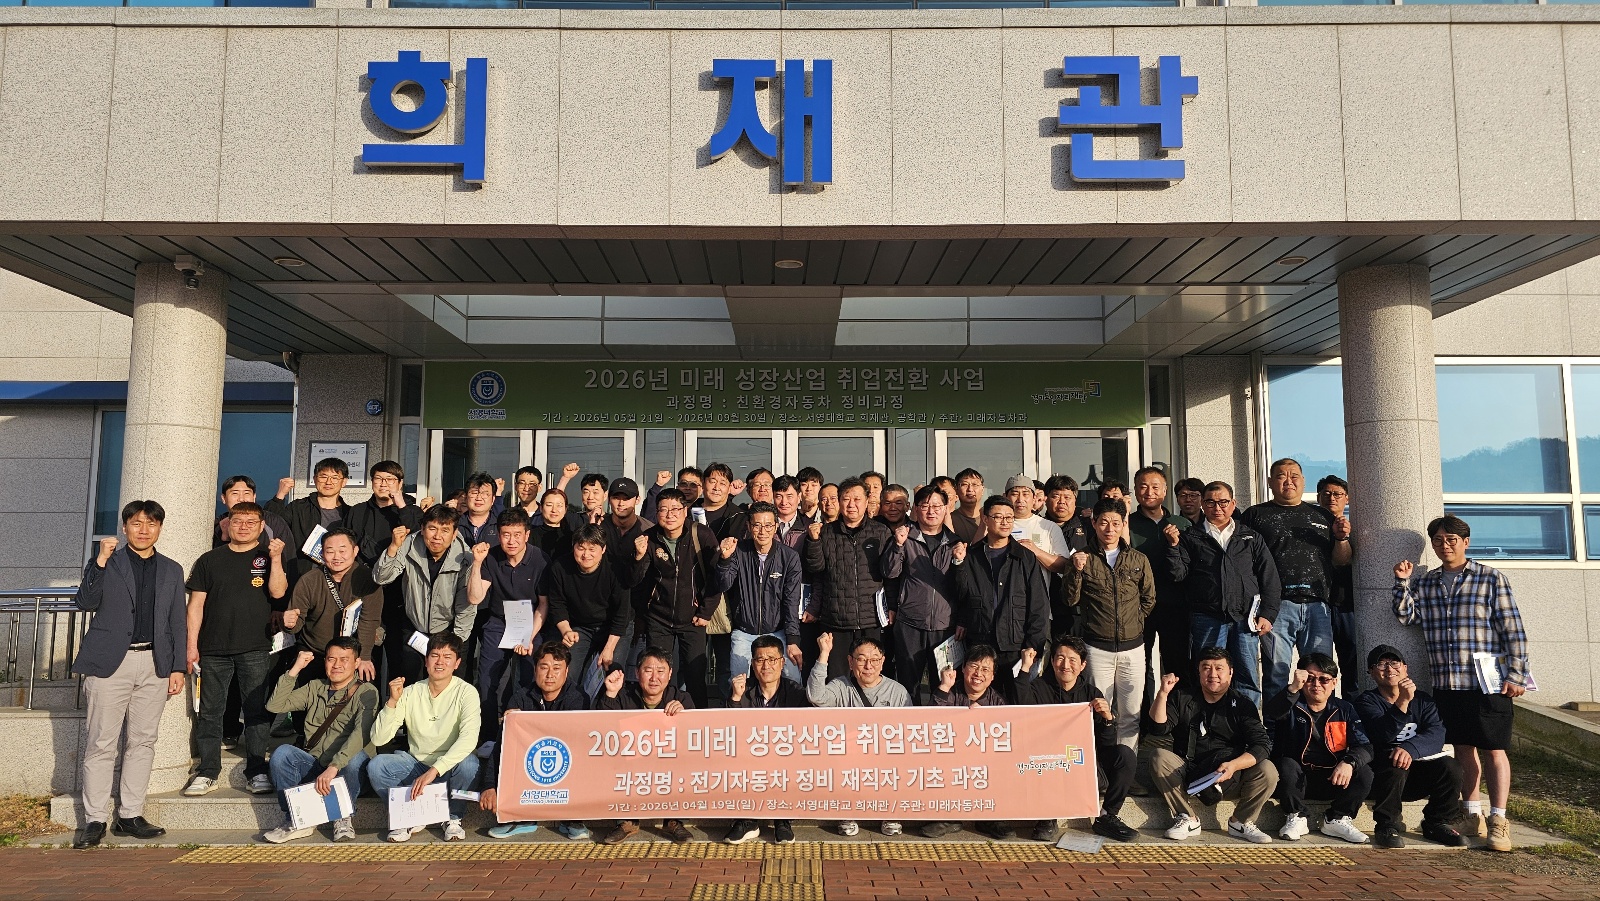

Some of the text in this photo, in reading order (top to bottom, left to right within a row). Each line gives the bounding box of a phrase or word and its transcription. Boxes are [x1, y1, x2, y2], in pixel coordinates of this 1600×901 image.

[361, 50, 1199, 185] 희 재 관
[584, 367, 985, 391] 2026년 미래 성장산업 취업전환 사업
[666, 394, 713, 410] 과정명
[736, 394, 832, 410] 친환경자동차
[841, 394, 904, 410] 정비과정
[542, 413, 562, 424] 기간
[573, 413, 610, 424] 2026년
[613, 413, 637, 424] 05월
[640, 413, 664, 424] 21일
[677, 413, 714, 424] 2026년
[717, 413, 740, 424] 09월
[743, 413, 767, 424] 30일
[779, 413, 802, 424] 장소:
[806, 413, 856, 424] 서영대학교
[859, 413, 893, 424] 희재관,
[897, 413, 927, 424] 공학관
[940, 413, 962, 424] 주관:
[967, 413, 1028, 424] 미래자동차과
[587, 721, 1013, 759] 2026년 미래 성장산업 취업전환 사업
[613, 771, 673, 796] 과정명
[690, 769, 790, 793] 전기자동차
[796, 768, 834, 792] 정비
[841, 767, 900, 792] 재직자
[906, 766, 945, 791] 기초
[950, 765, 989, 790] 과정
[521, 789, 569, 799] 서영대학교
[608, 803, 631, 812] 기간
[640, 801, 680, 811] 2026년
[682, 800, 708, 810] 04월
[711, 799, 756, 811] 19일(일)
[767, 799, 793, 811] 장소:
[795, 799, 852, 811] 서영대학교
[856, 799, 890, 812] 희재관
[899, 800, 926, 812] 주관:
[929, 799, 996, 812] 미래자동차과
